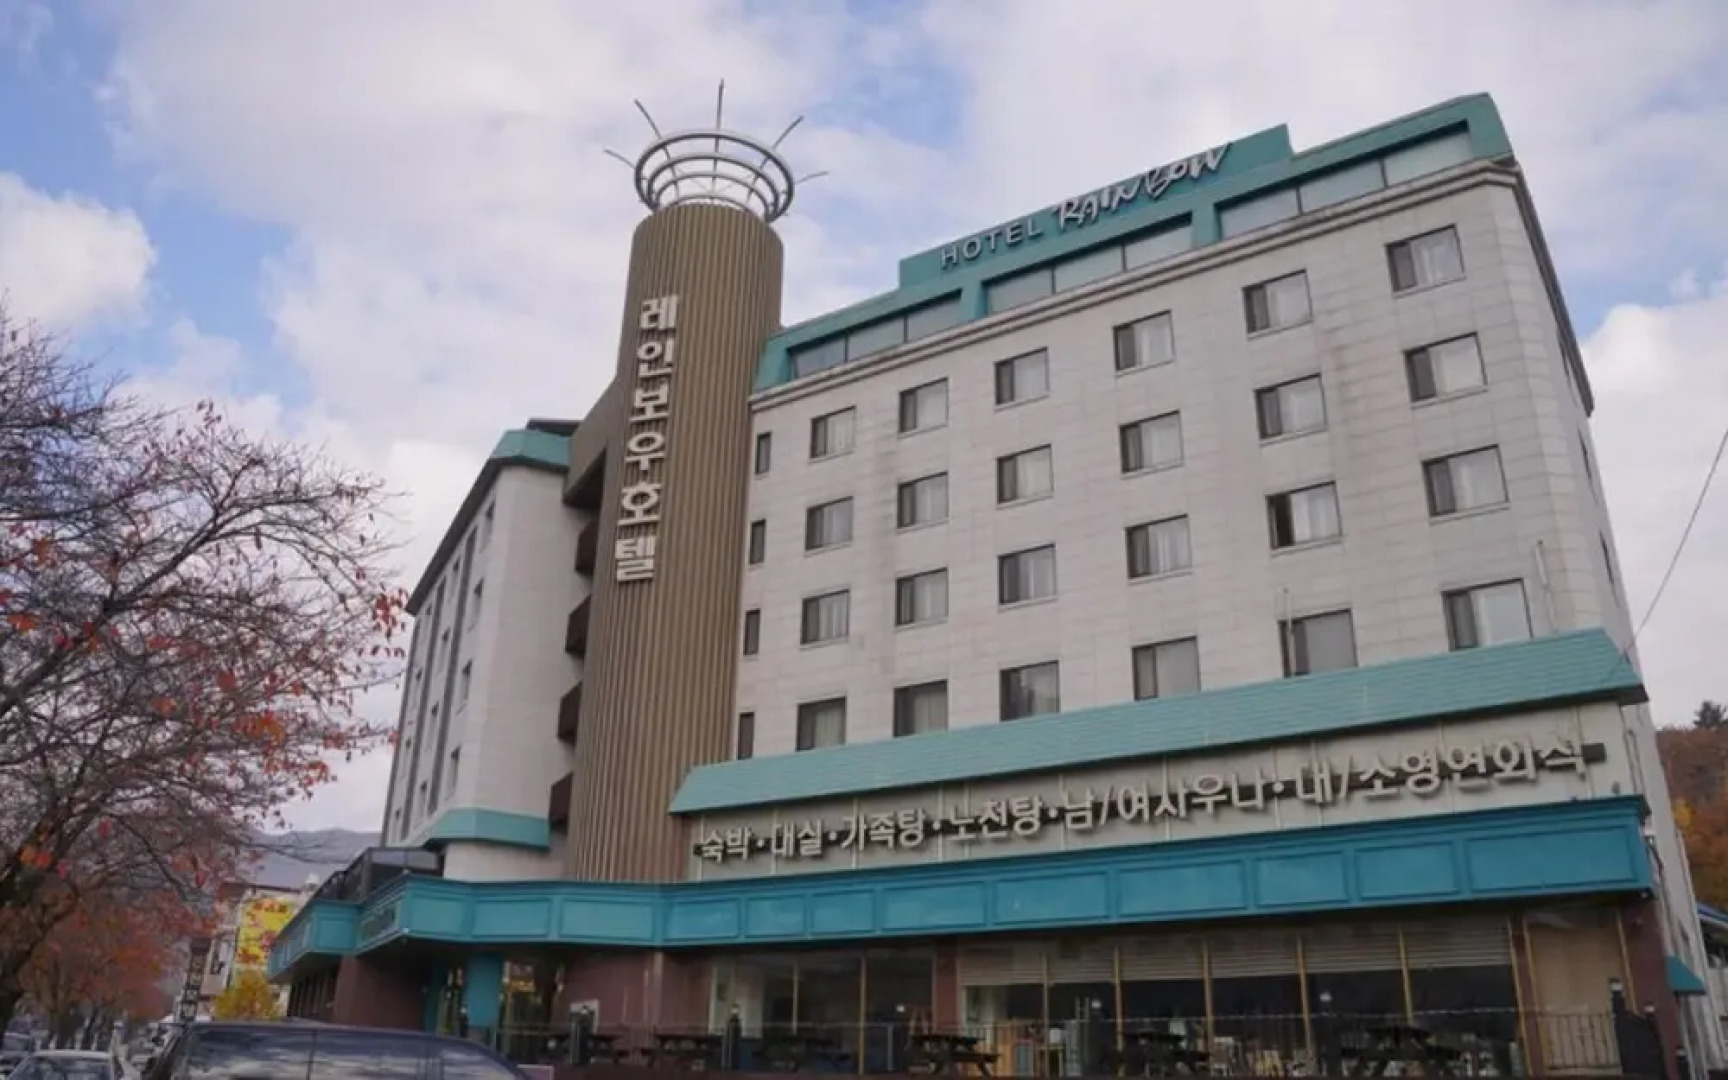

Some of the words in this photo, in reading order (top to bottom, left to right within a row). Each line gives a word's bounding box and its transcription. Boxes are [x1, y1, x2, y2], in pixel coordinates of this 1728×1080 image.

[940, 216, 1044, 269] HOTEL
[1053, 141, 1232, 231] RAINBOW
[614, 295, 678, 583] 레인보우호텔
